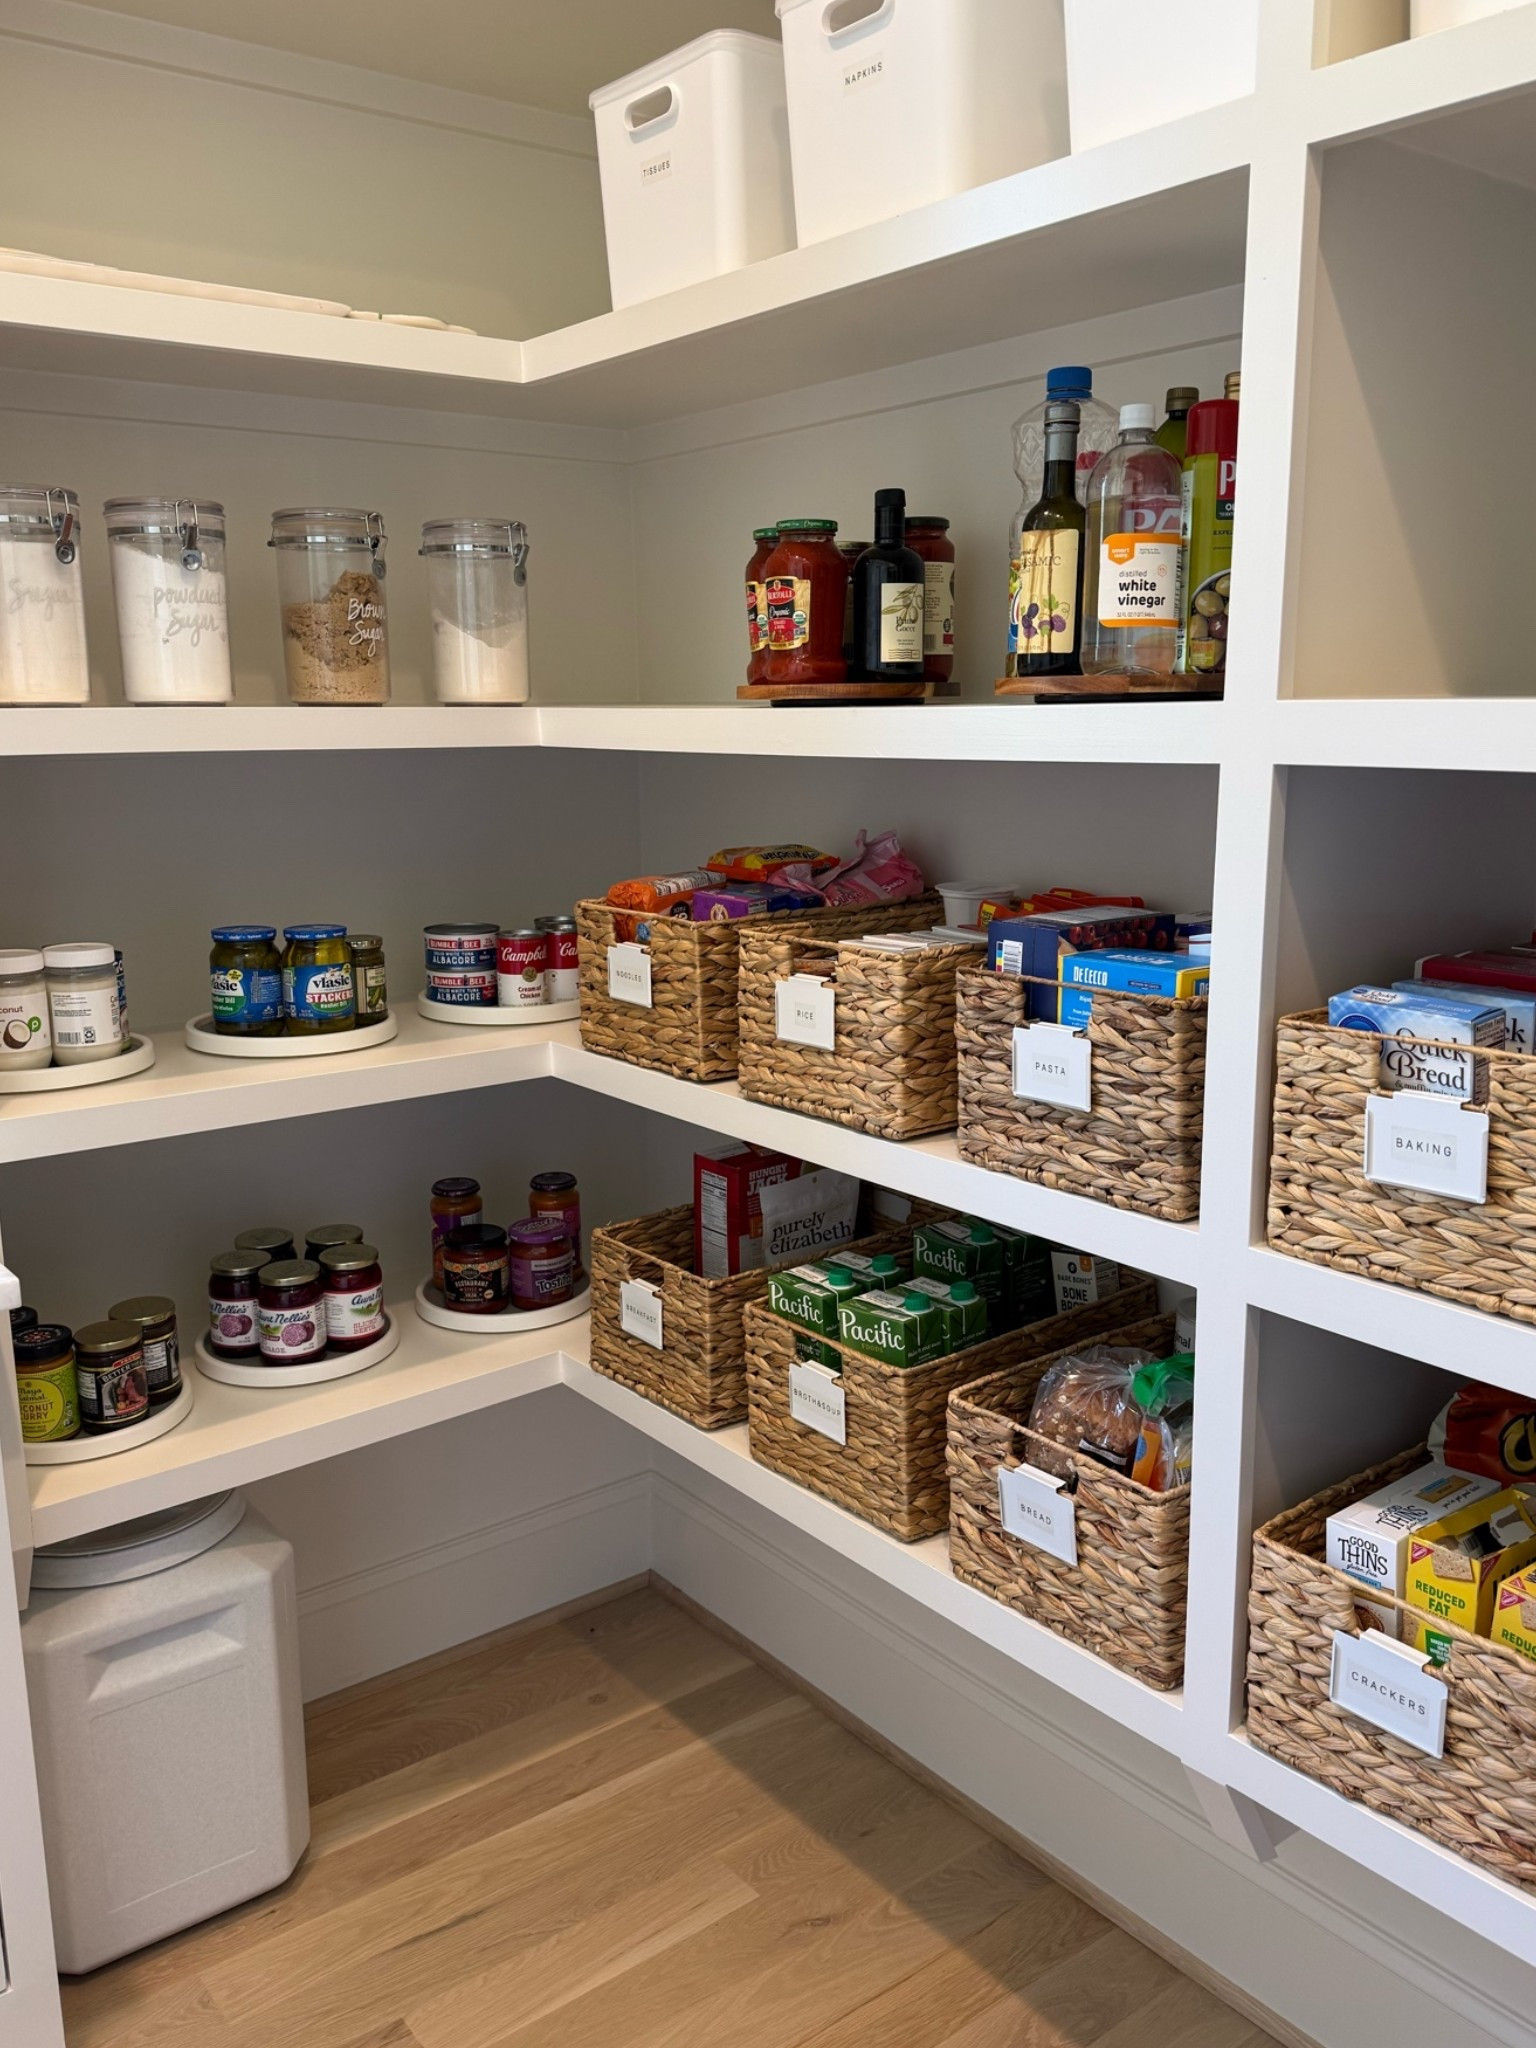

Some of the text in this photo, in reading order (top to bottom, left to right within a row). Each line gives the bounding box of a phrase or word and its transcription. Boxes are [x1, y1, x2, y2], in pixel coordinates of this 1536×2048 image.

[845, 61, 883, 86] NAPKINS
[642, 160, 671, 178] TISSUES
[1119, 579, 1157, 591] white
[348, 598, 387, 621] Brown
[1118, 593, 1166, 608] vinegar
[166, 608, 220, 648] Sugar
[349, 620, 385, 657] Sugar
[430, 940, 480, 949] BUMBLE BEE
[432, 956, 476, 965] ALBACORE
[313, 975, 350, 989] vlasic
[434, 977, 484, 986] BUMBLE BEE
[616, 970, 642, 983] NOODLES
[306, 989, 353, 1003] STACKERS
[437, 992, 481, 1001] ALBACORE
[796, 1009, 814, 1021] RICE
[1035, 1062, 1066, 1076] PASTA
[1386, 1050, 1467, 1092] Bread
[1396, 1138, 1452, 1157] BAKING
[748, 1163, 788, 1181] HUNGRY
[772, 1212, 826, 1241] purely
[770, 1221, 853, 1255] elizabeth
[914, 1235, 967, 1276] Pacific
[768, 1280, 823, 1324] Pacific
[1063, 1287, 1088, 1302] BONE
[275, 1311, 312, 1324] Nellie's
[626, 1304, 657, 1325] BREAKFAST
[839, 1308, 906, 1350] Pacific
[101, 1364, 132, 1383] BETTER
[793, 1387, 842, 1417] BROTH&SOUP
[1020, 1503, 1053, 1526] BREAD
[1375, 1505, 1429, 1530] THINS
[1349, 1536, 1378, 1554] GOOD
[1338, 1537, 1388, 1576] THINS
[1415, 1579, 1466, 1610] REDUCED
[1428, 1598, 1451, 1617] FAT
[1351, 1670, 1426, 1716] CRACKERS
